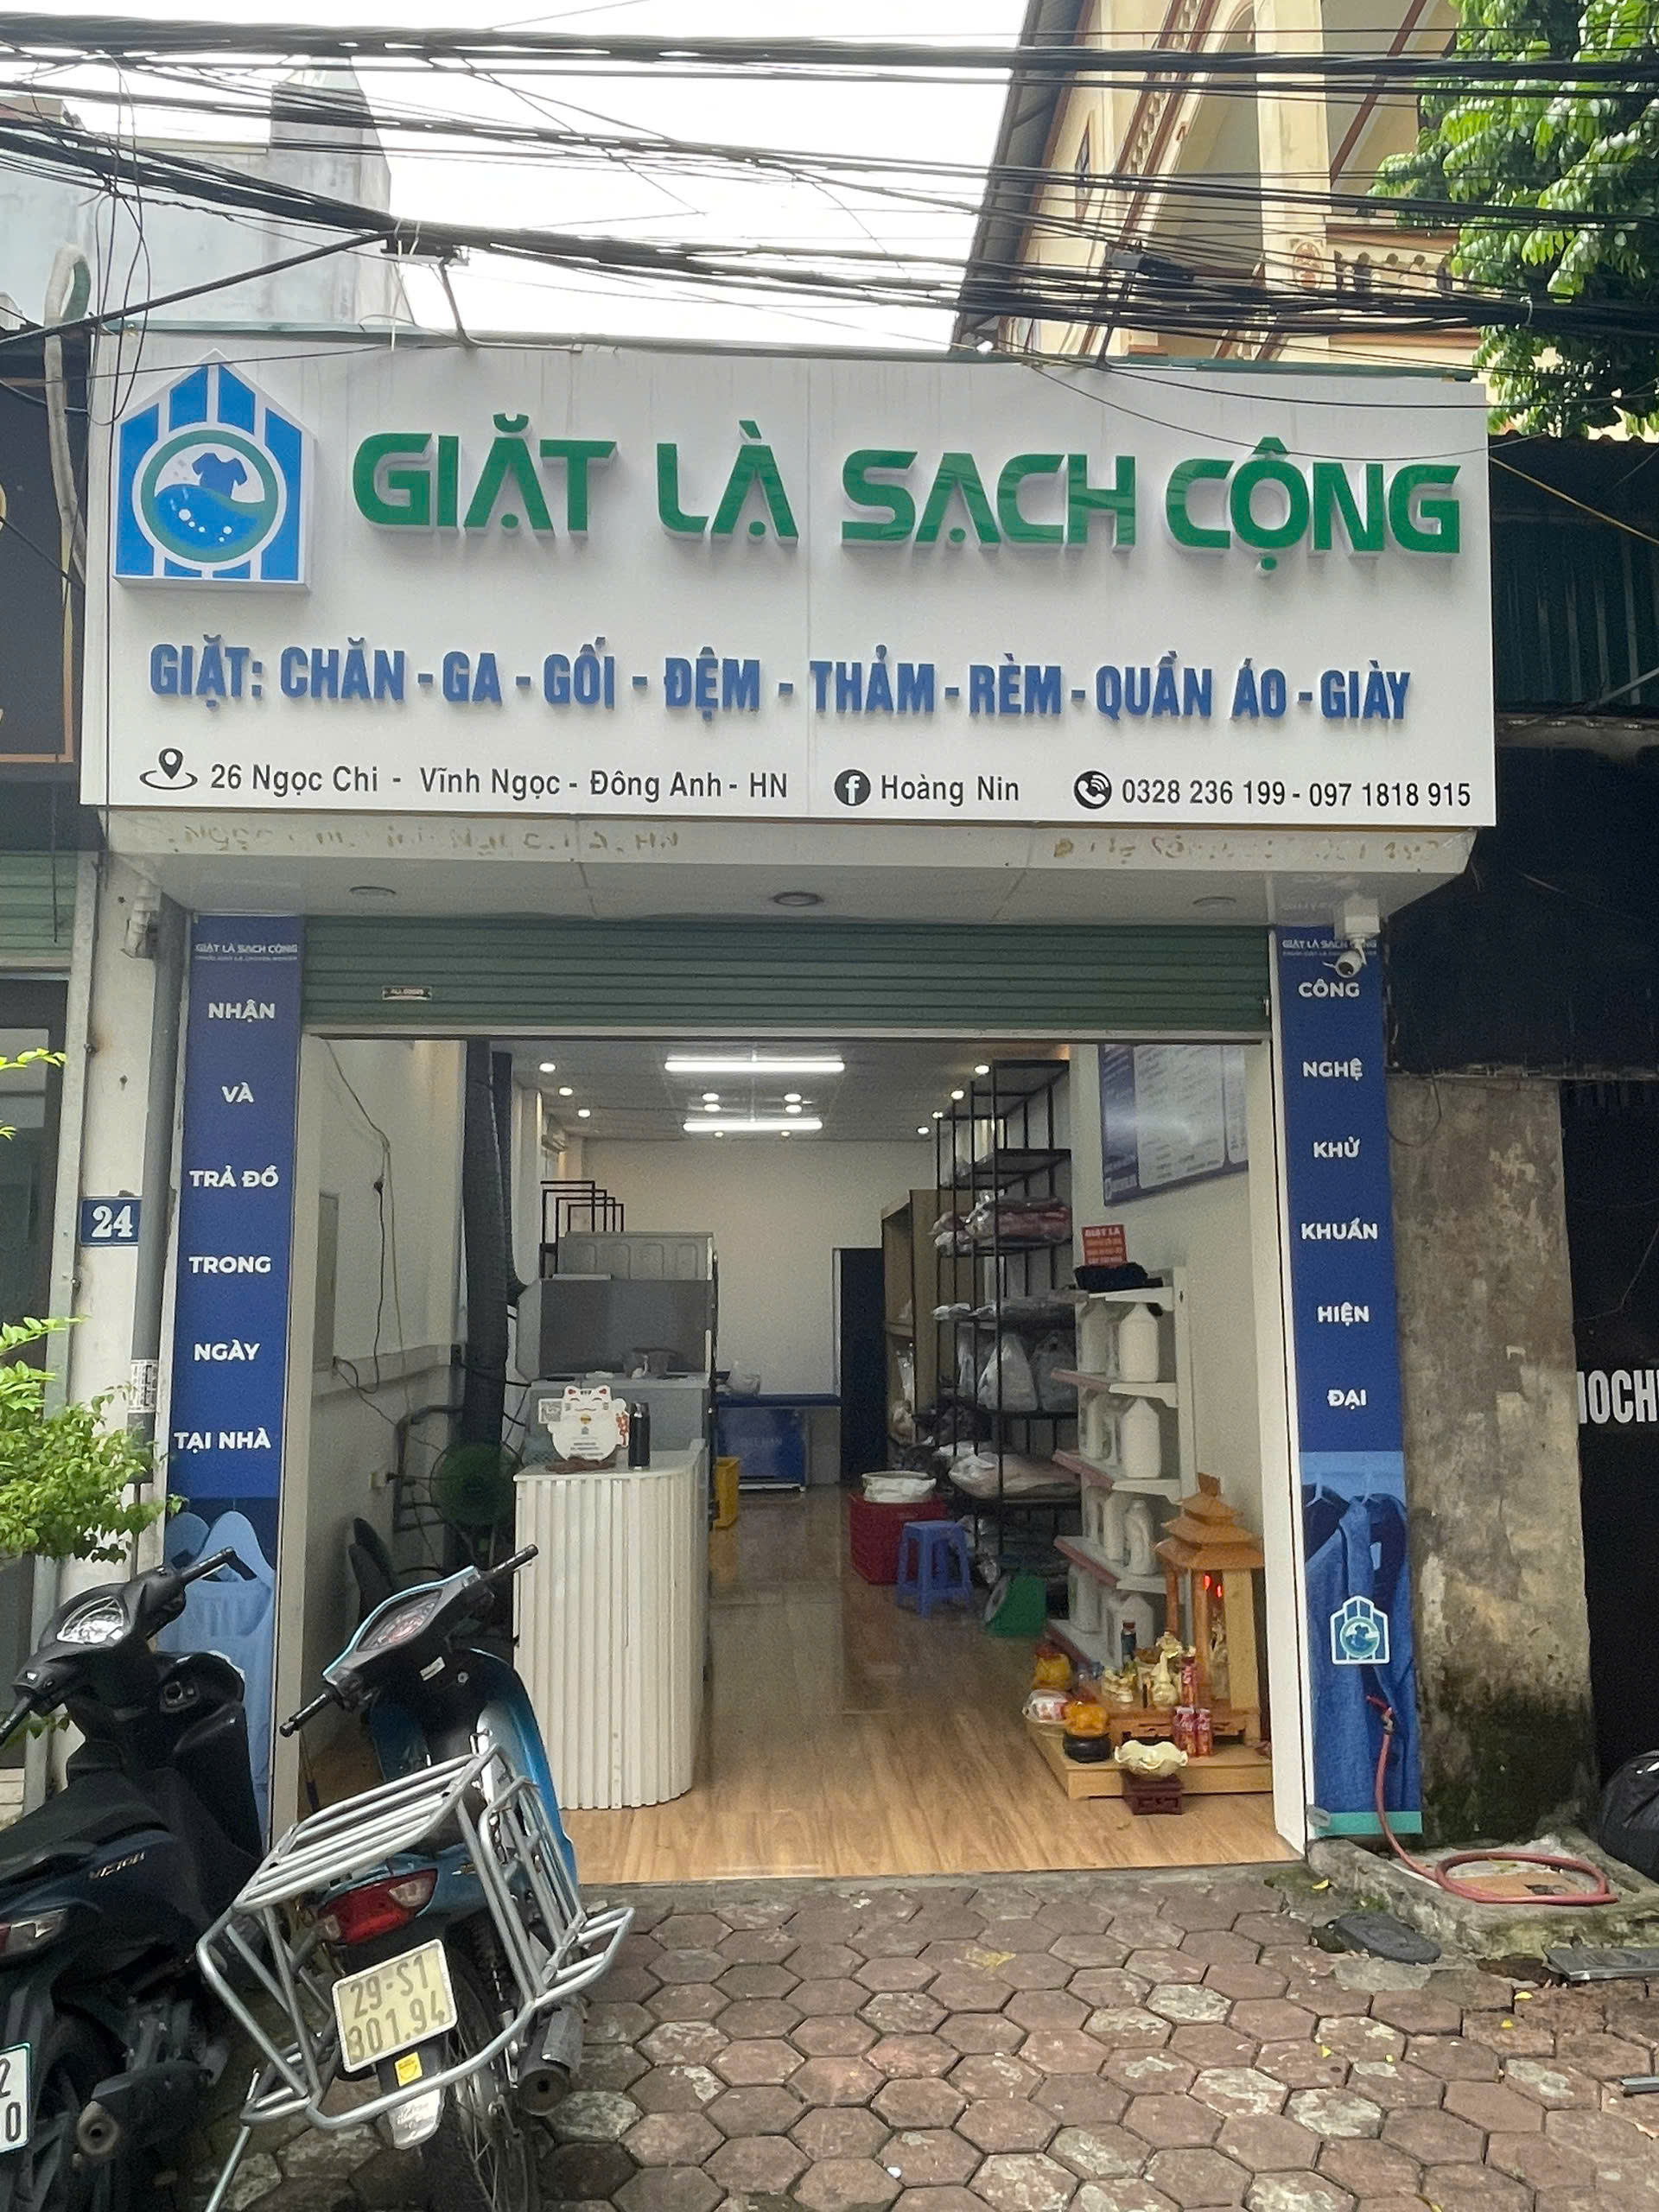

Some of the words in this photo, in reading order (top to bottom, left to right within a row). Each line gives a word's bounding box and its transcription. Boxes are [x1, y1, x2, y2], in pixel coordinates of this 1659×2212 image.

[1166, 436, 1461, 574] CỘNG
[149, 635, 264, 707] GIẶT:
[280, 637, 405, 702] CHĂN
[442, 651, 502, 704] GA
[543, 636, 615, 709] GỐI
[664, 646, 760, 721] ĐỆM
[810, 644, 935, 712] THẢM
[969, 652, 1062, 715] RÈM
[1096, 650, 1212, 721] QUẦN
[1230, 658, 1287, 721] ÁO
[1320, 659, 1411, 720] GIÀY
[210, 764, 242, 791] 26
[252, 765, 322, 798] Ngọc
[333, 766, 378, 792] Chi
[420, 766, 480, 794] Vĩnh
[492, 767, 560, 801] Ngọc
[590, 769, 659, 804] Đông
[670, 772, 721, 798] Anh
[750, 772, 787, 799] HN
[880, 773, 963, 807] Hoàng
[977, 776, 1019, 802] Nin
[1122, 779, 1180, 804] 0328
[1190, 780, 1233, 804] 236
[1243, 780, 1286, 805] 199
[1309, 782, 1352, 807] 097
[1362, 782, 1419, 807] 1818
[1427, 783, 1471, 807] 915
[1298, 978, 1360, 998] CÔNG
[207, 999, 276, 1022] NHẬN
[1302, 1057, 1363, 1081] NGHỆ
[221, 1082, 254, 1103] VÀ
[1313, 1135, 1361, 1159] KHỬ
[189, 1165, 237, 1188] TRẢ
[92, 1205, 133, 1238] 24
[188, 1255, 271, 1274] TRONG
[1317, 1301, 1370, 1326] HIỆN
[194, 1338, 261, 1362] NGÀY
[1326, 1389, 1367, 1410] ĐẠI
[174, 1431, 212, 1453] TẠI
[219, 1427, 271, 1450] NHÀ
